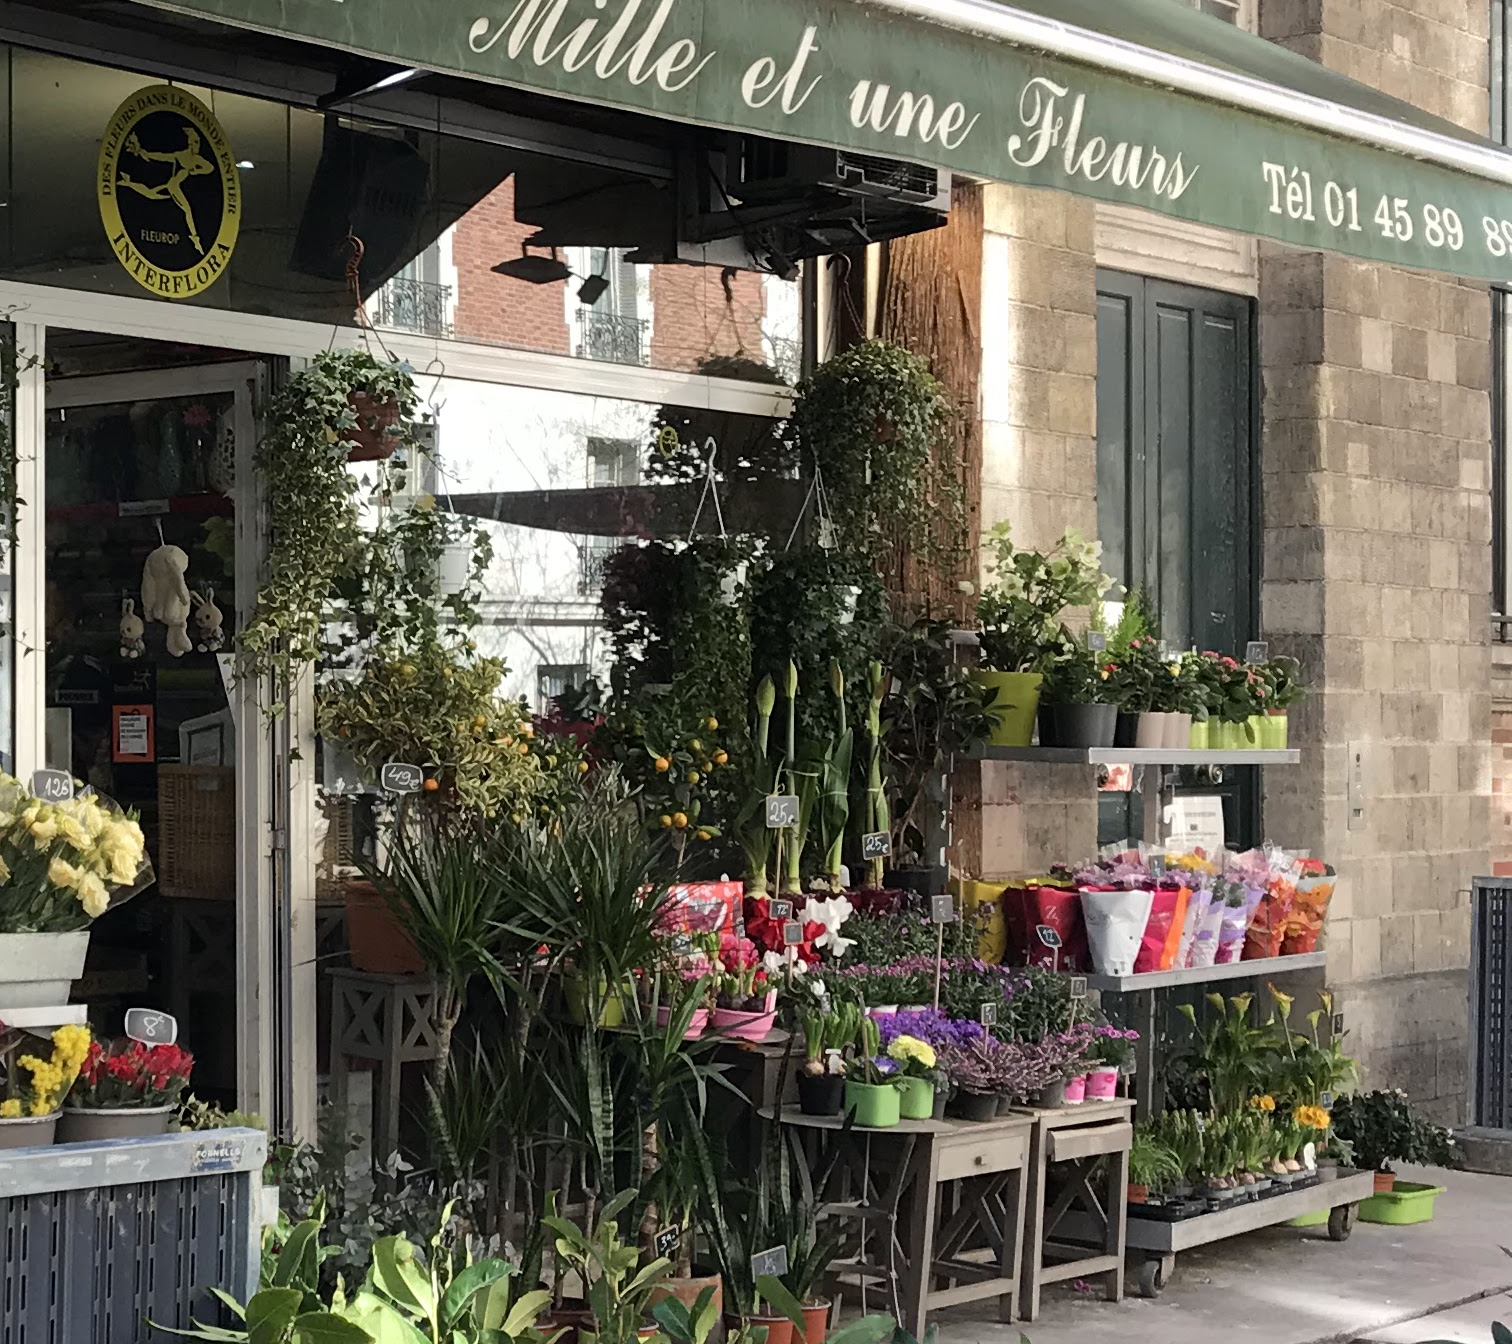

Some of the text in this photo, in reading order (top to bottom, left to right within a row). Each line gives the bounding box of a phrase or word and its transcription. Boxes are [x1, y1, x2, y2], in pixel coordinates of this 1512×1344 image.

[102, 92, 237, 214] DES FLEURS DANS LE MONDE ENTIER
[741, 26, 824, 114] et
[850, 80, 981, 149] une
[1008, 77, 1199, 199] Fleurs
[141, 230, 180, 244] FLEUROP
[1263, 161, 1315, 222] Tél
[1324, 181, 1362, 231] 01
[1375, 197, 1414, 242] 45
[1424, 203, 1464, 251] 89
[113, 231, 230, 293] INTERFLORA
